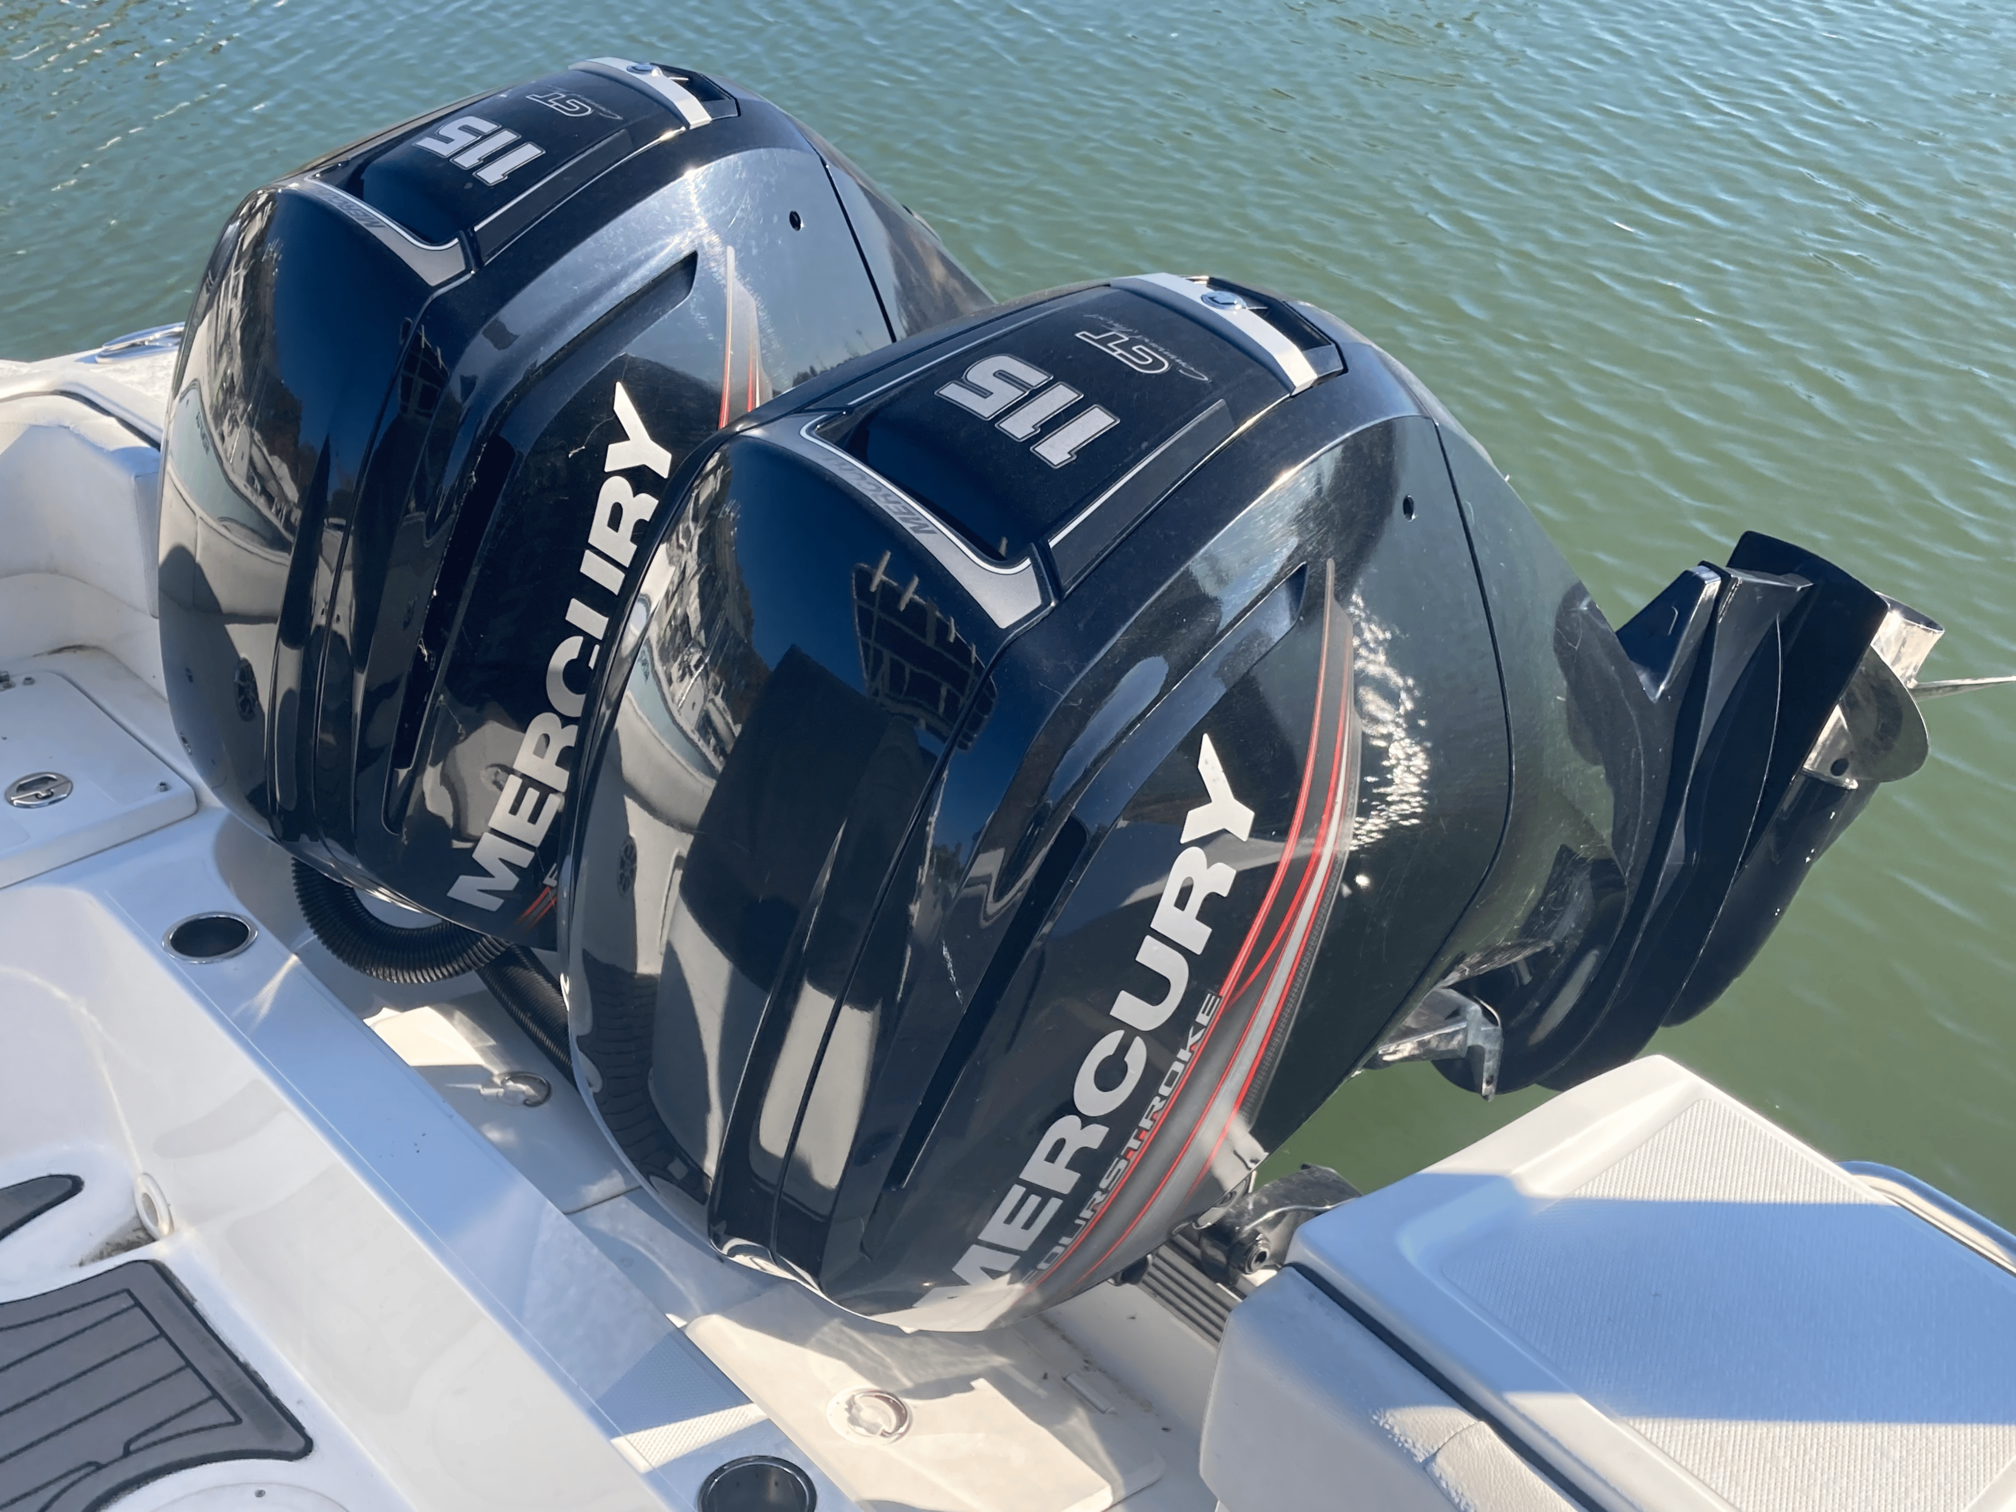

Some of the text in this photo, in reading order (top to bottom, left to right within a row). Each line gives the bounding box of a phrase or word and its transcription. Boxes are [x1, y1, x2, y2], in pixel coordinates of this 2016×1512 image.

[412, 115, 546, 187] 115
[934, 353, 1120, 469] 115
[447, 381, 672, 912] MERCURY
[912, 733, 1255, 1308] MERCURY
